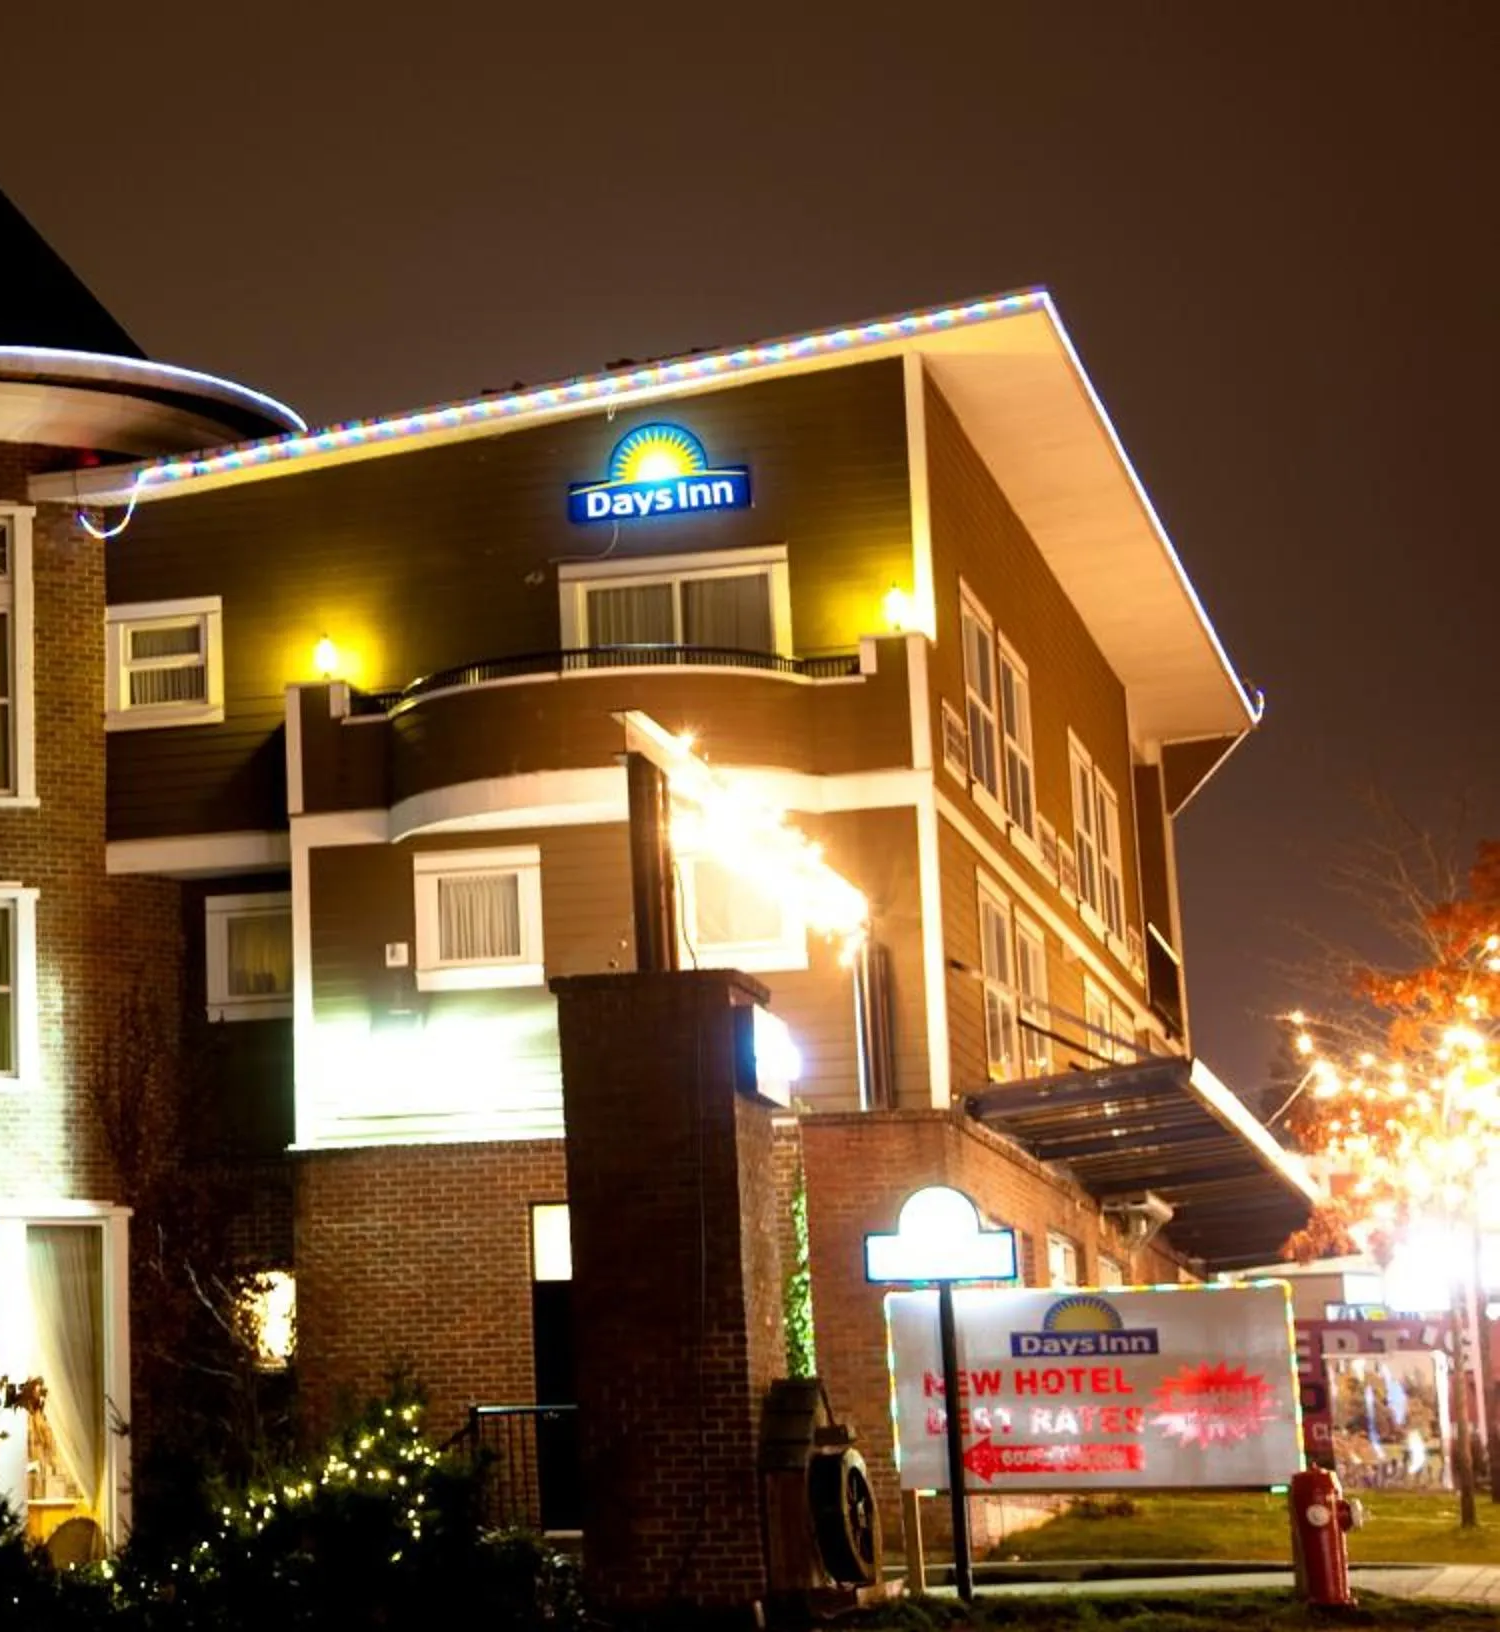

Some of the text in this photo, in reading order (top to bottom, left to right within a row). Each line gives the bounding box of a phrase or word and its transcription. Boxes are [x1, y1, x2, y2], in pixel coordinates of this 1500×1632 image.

[586, 480, 735, 519] Days Inn
[1018, 1334, 1151, 1355] Days Inn
[923, 1367, 1134, 1397] NEW HOTEL
[1030, 1404, 1145, 1434] RATES
